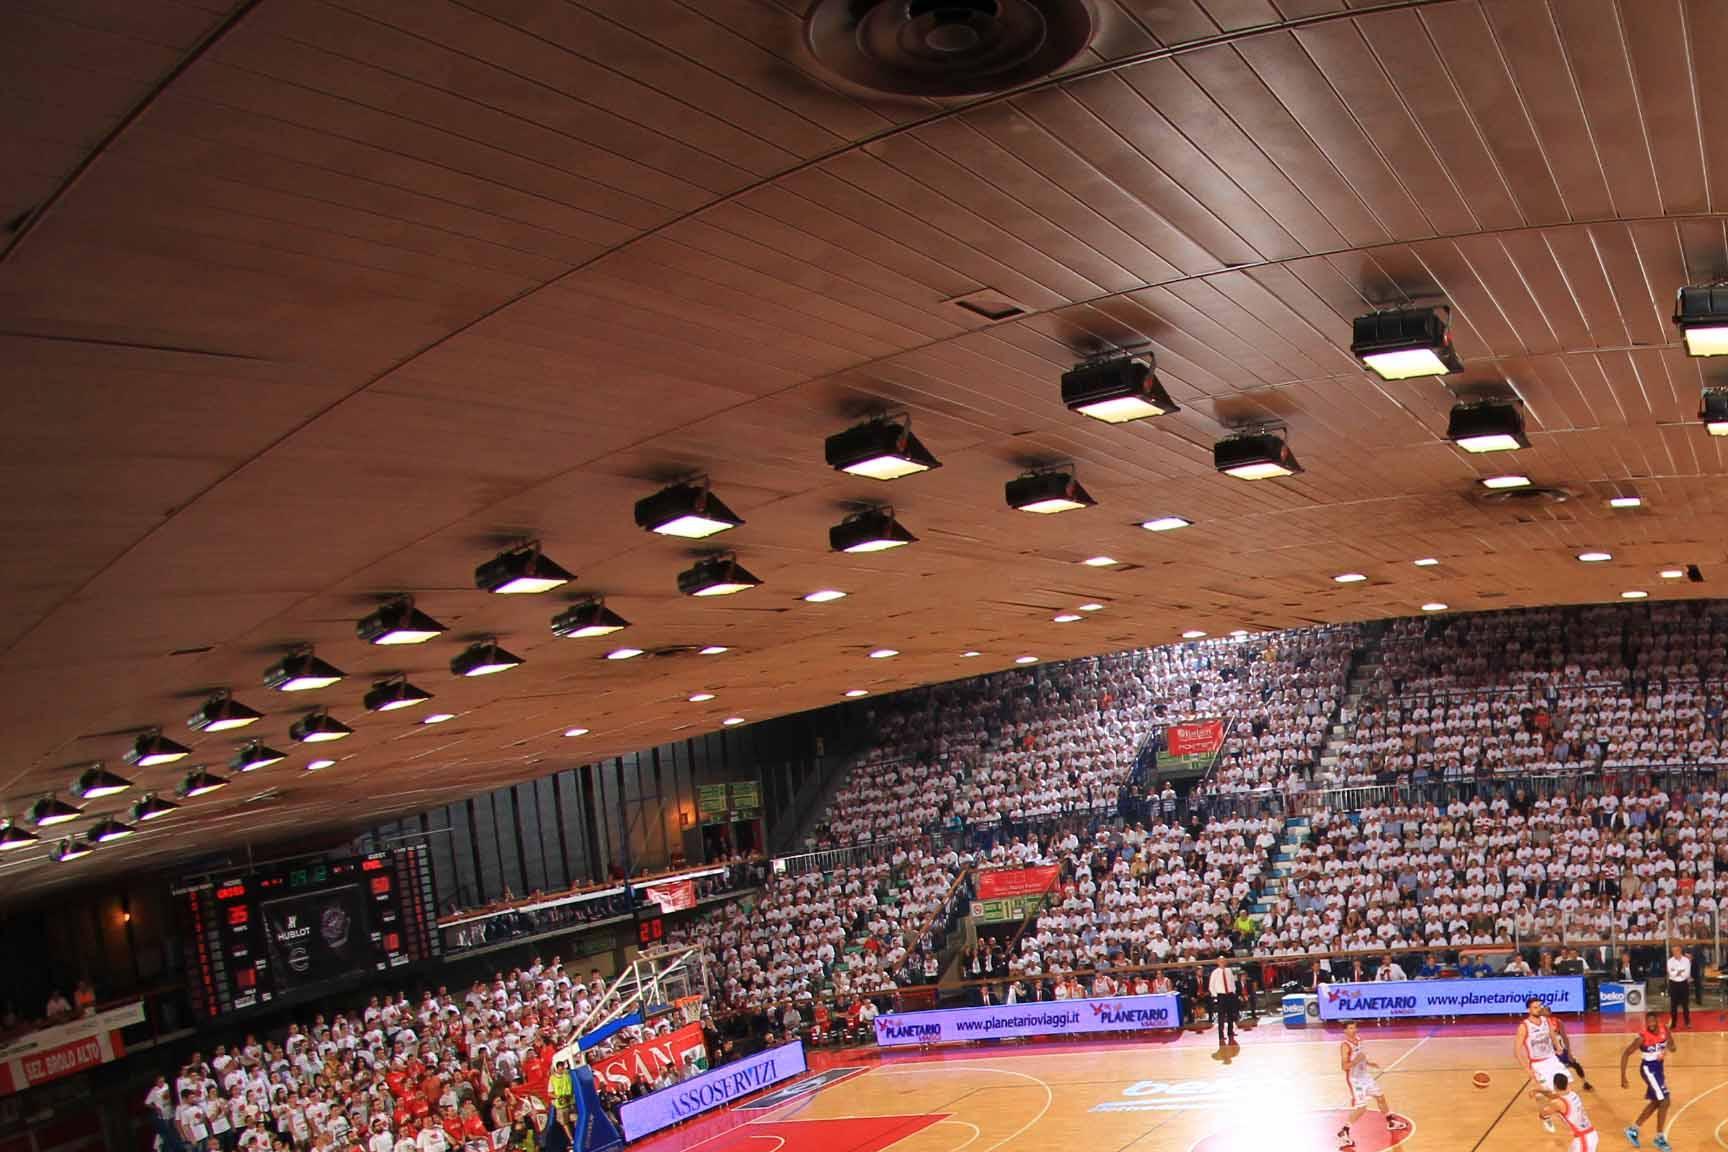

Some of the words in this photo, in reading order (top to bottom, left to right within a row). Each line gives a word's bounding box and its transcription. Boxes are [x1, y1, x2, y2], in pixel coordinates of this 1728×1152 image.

[277, 926, 311, 940] HUBLOT
[1338, 996, 1416, 1011] PLANETARIO
[1600, 991, 1624, 1001] beko
[956, 1011, 1080, 1032] www.planetarioviaggi.it
[1101, 1008, 1168, 1024] PLANETARIO
[886, 1023, 941, 1039] PLANETARIO
[670, 1059, 778, 1120] ASSOSERVIZI
